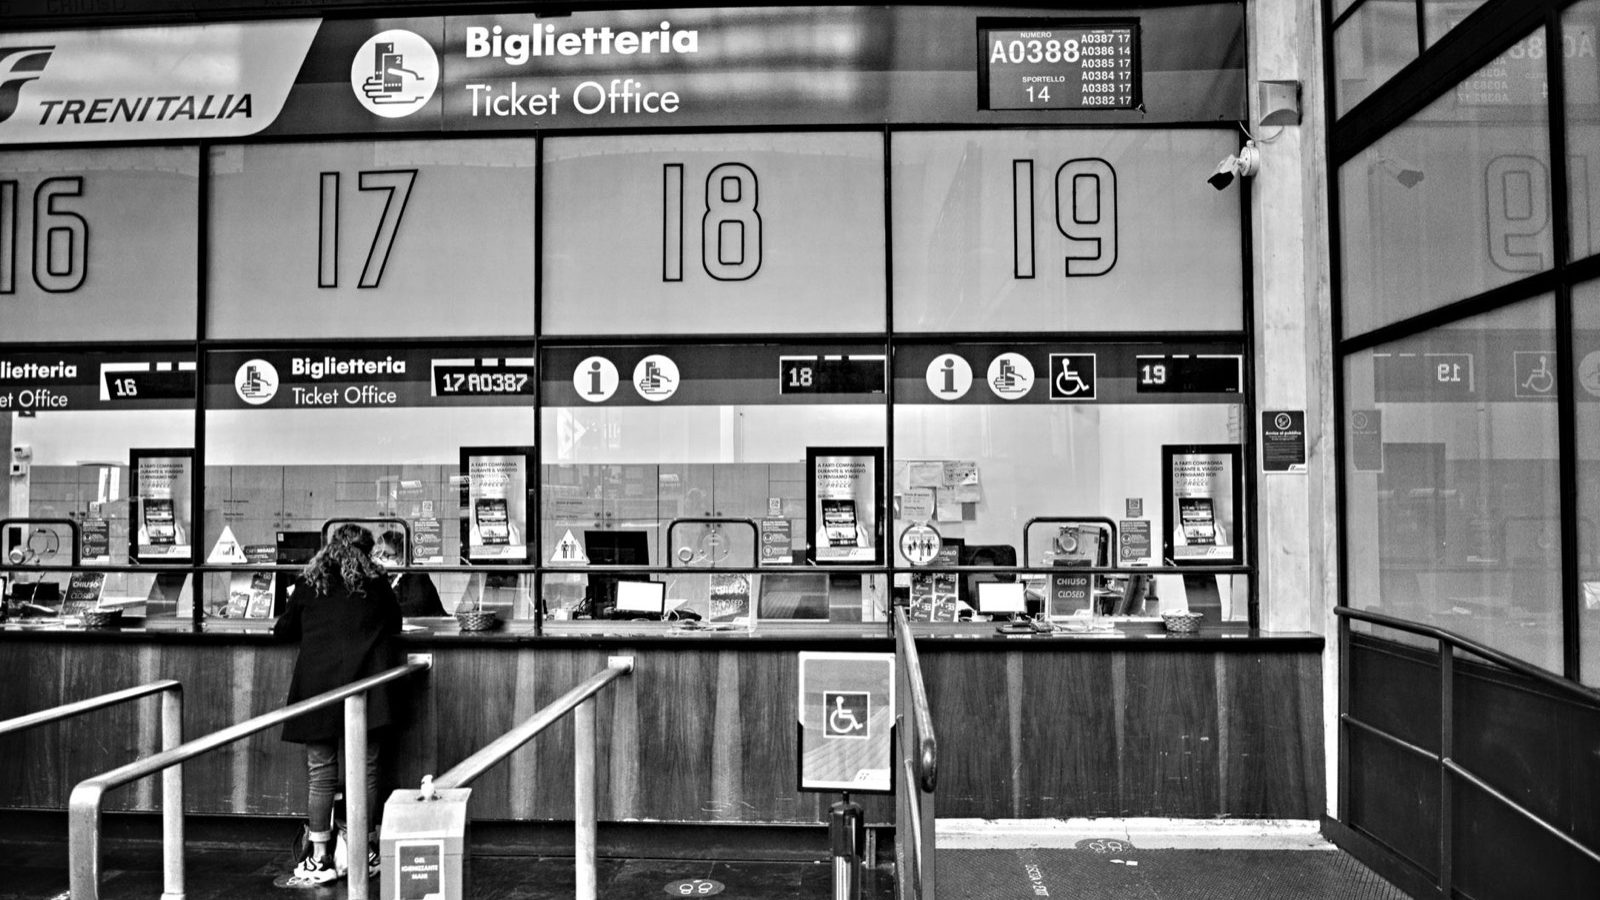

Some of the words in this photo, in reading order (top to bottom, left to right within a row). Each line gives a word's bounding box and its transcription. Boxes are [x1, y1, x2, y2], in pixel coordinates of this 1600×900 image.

[465, 21, 698, 65] Biglietteria
[1081, 34, 1114, 44] A0387
[1118, 34, 1131, 43] 17
[990, 39, 1080, 64] A0388
[1081, 46, 1114, 56] A0386
[1118, 46, 1131, 55] 14
[1081, 59, 1115, 68] A0385
[1118, 59, 1131, 67] 17
[1022, 75, 1066, 83] SPORTELLO
[1081, 71, 1115, 81] A0384
[1118, 71, 1131, 80] 17
[465, 81, 561, 116] Ticket
[572, 78, 680, 115] Office
[1025, 85, 1051, 103] 14
[1081, 83, 1115, 93] A0383
[1118, 83, 1131, 92] 17
[39, 93, 252, 126] TRENITALIA
[1081, 96, 1115, 105] A0382
[1118, 96, 1132, 105] 17
[317, 168, 419, 289] 17
[661, 162, 763, 282] 18
[1012, 157, 1118, 280] 19
[0, 176, 89, 294] 16
[291, 356, 406, 380] Biglietteria
[789, 367, 813, 387] 18
[1142, 364, 1166, 384] 19
[114, 378, 138, 396] 16
[442, 373, 464, 392] 17
[467, 372, 528, 392] A0387
[18, 389, 68, 408] Office
[291, 386, 339, 405] Ticket
[344, 385, 397, 404] Office
[1056, 577, 1088, 586] CHIUSO
[1057, 590, 1085, 598] CLOSED
